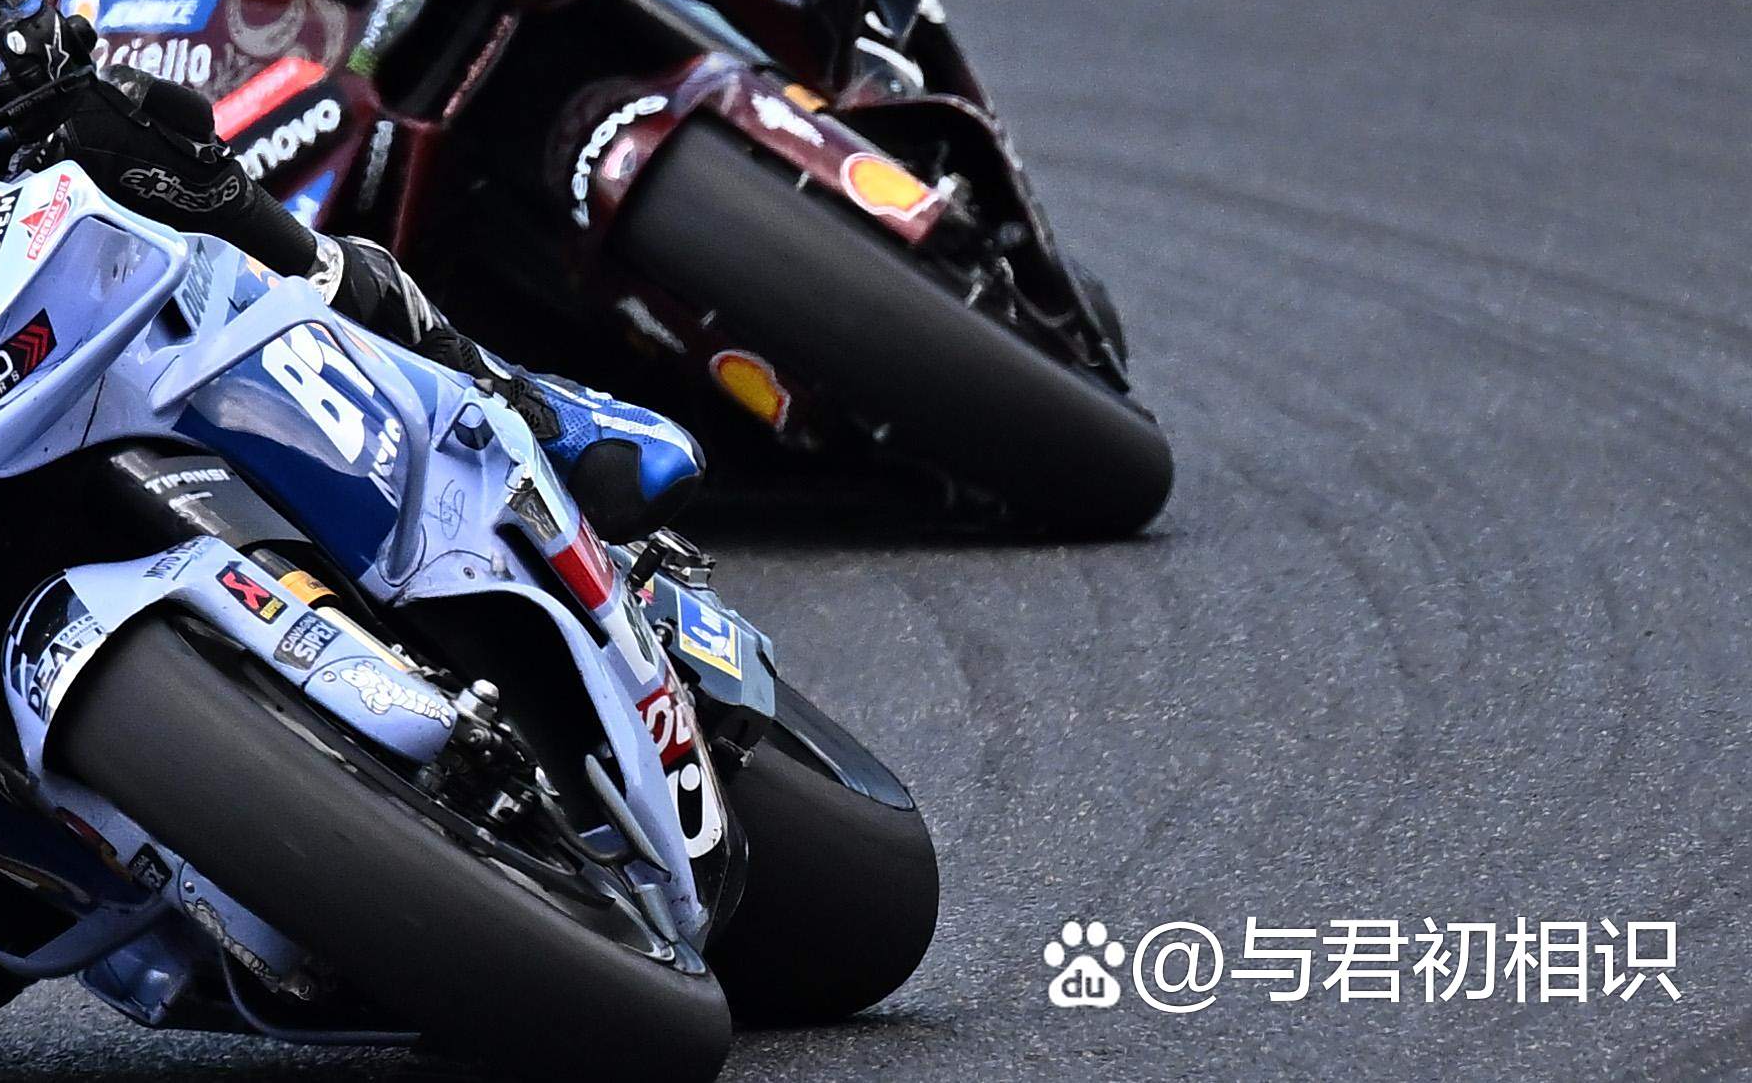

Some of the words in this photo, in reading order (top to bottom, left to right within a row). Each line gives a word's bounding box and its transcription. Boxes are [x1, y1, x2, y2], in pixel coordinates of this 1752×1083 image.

[235, 99, 340, 180] novo
[28, 202, 61, 259] FEDERAL
[295, 623, 338, 663] SIPEX
